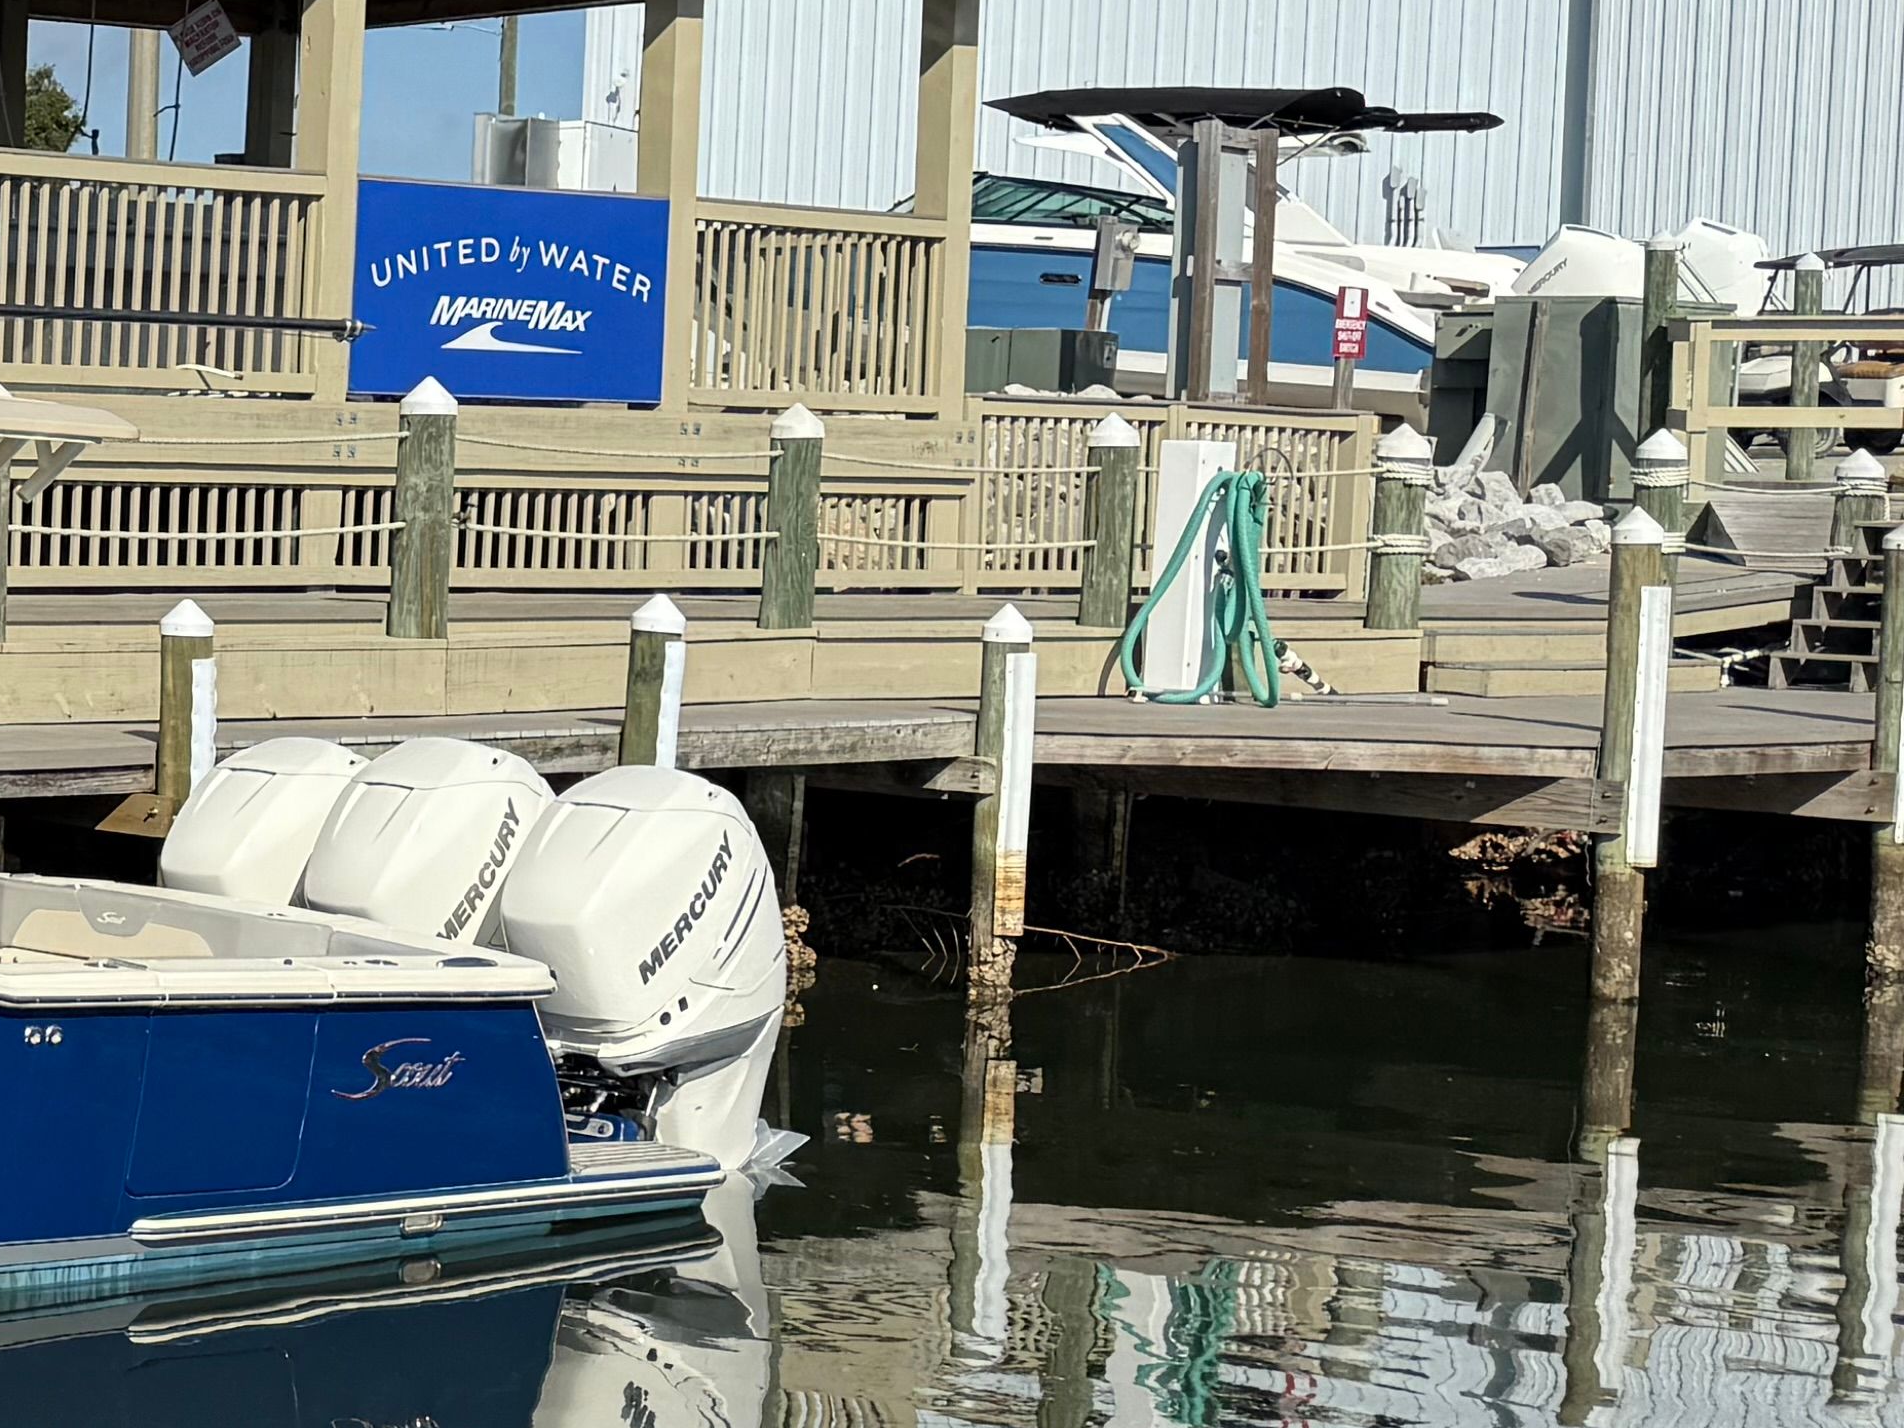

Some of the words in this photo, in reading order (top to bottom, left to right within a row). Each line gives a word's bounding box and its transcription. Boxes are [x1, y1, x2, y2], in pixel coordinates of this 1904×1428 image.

[370, 237, 501, 287] UNITED
[508, 235, 531, 273] by
[538, 240, 652, 303] WATER
[435, 796, 521, 942] MERCURY
[638, 828, 735, 986] MERCURY
[330, 1037, 467, 1101] Scout
